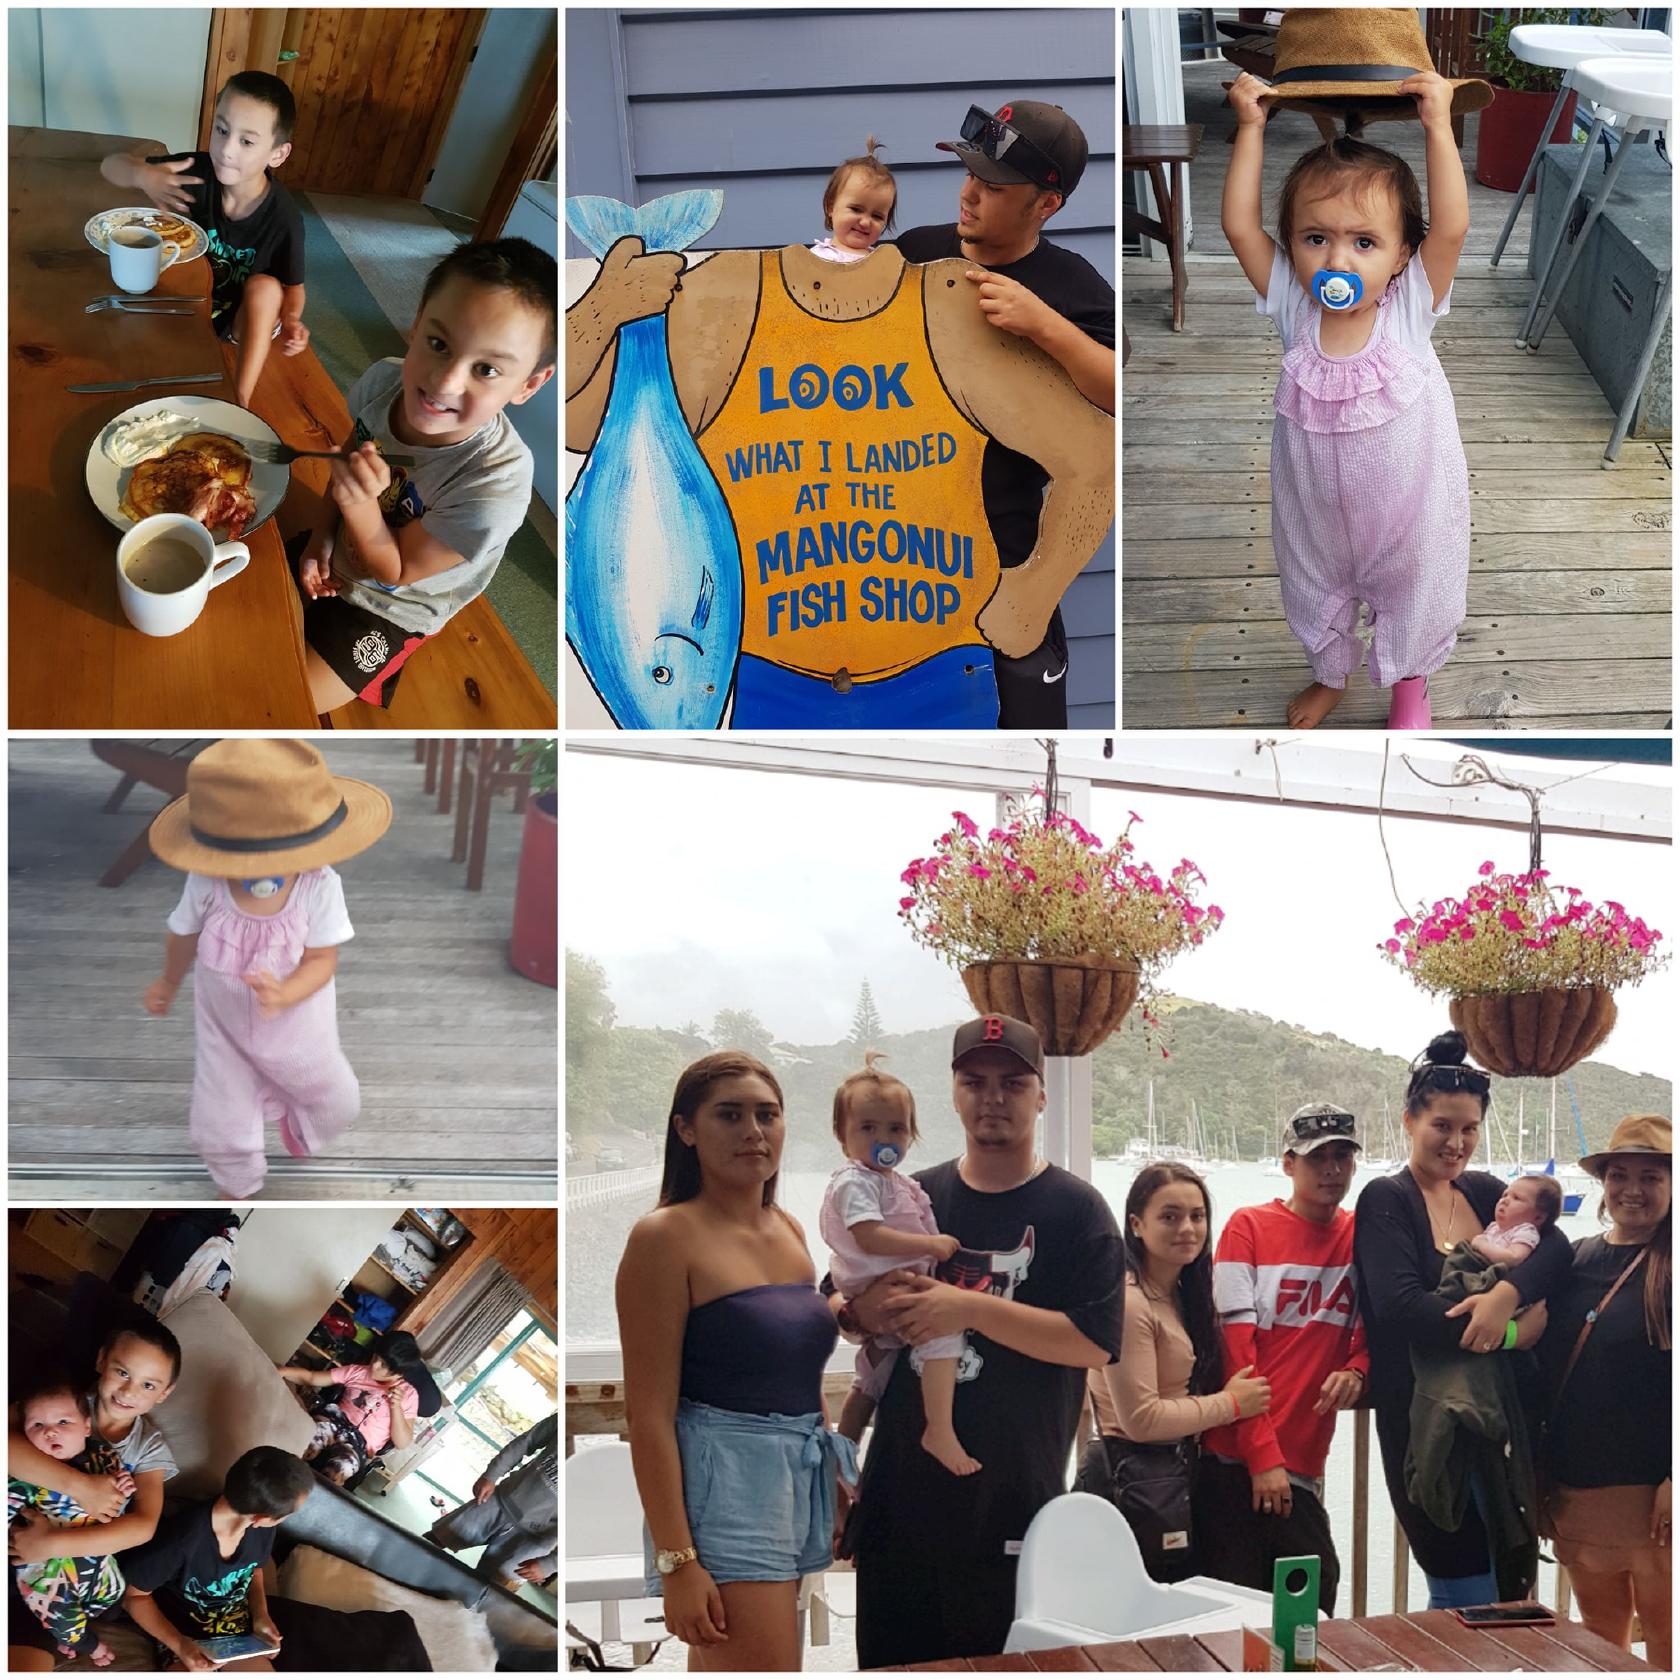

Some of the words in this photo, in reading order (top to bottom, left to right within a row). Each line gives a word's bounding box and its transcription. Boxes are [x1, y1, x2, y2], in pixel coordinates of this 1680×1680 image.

[759, 363, 914, 413] LOOK
[725, 440, 803, 482] WHAT
[818, 441, 832, 473] I
[846, 432, 957, 473] LANDED
[794, 483, 830, 514] AT
[845, 482, 896, 510] THE
[756, 520, 973, 584] MANGONUI
[767, 580, 846, 636] FISH
[860, 576, 960, 625] SHOP
[983, 1015, 1004, 1040] B
[1276, 1276, 1355, 1316] FILA
